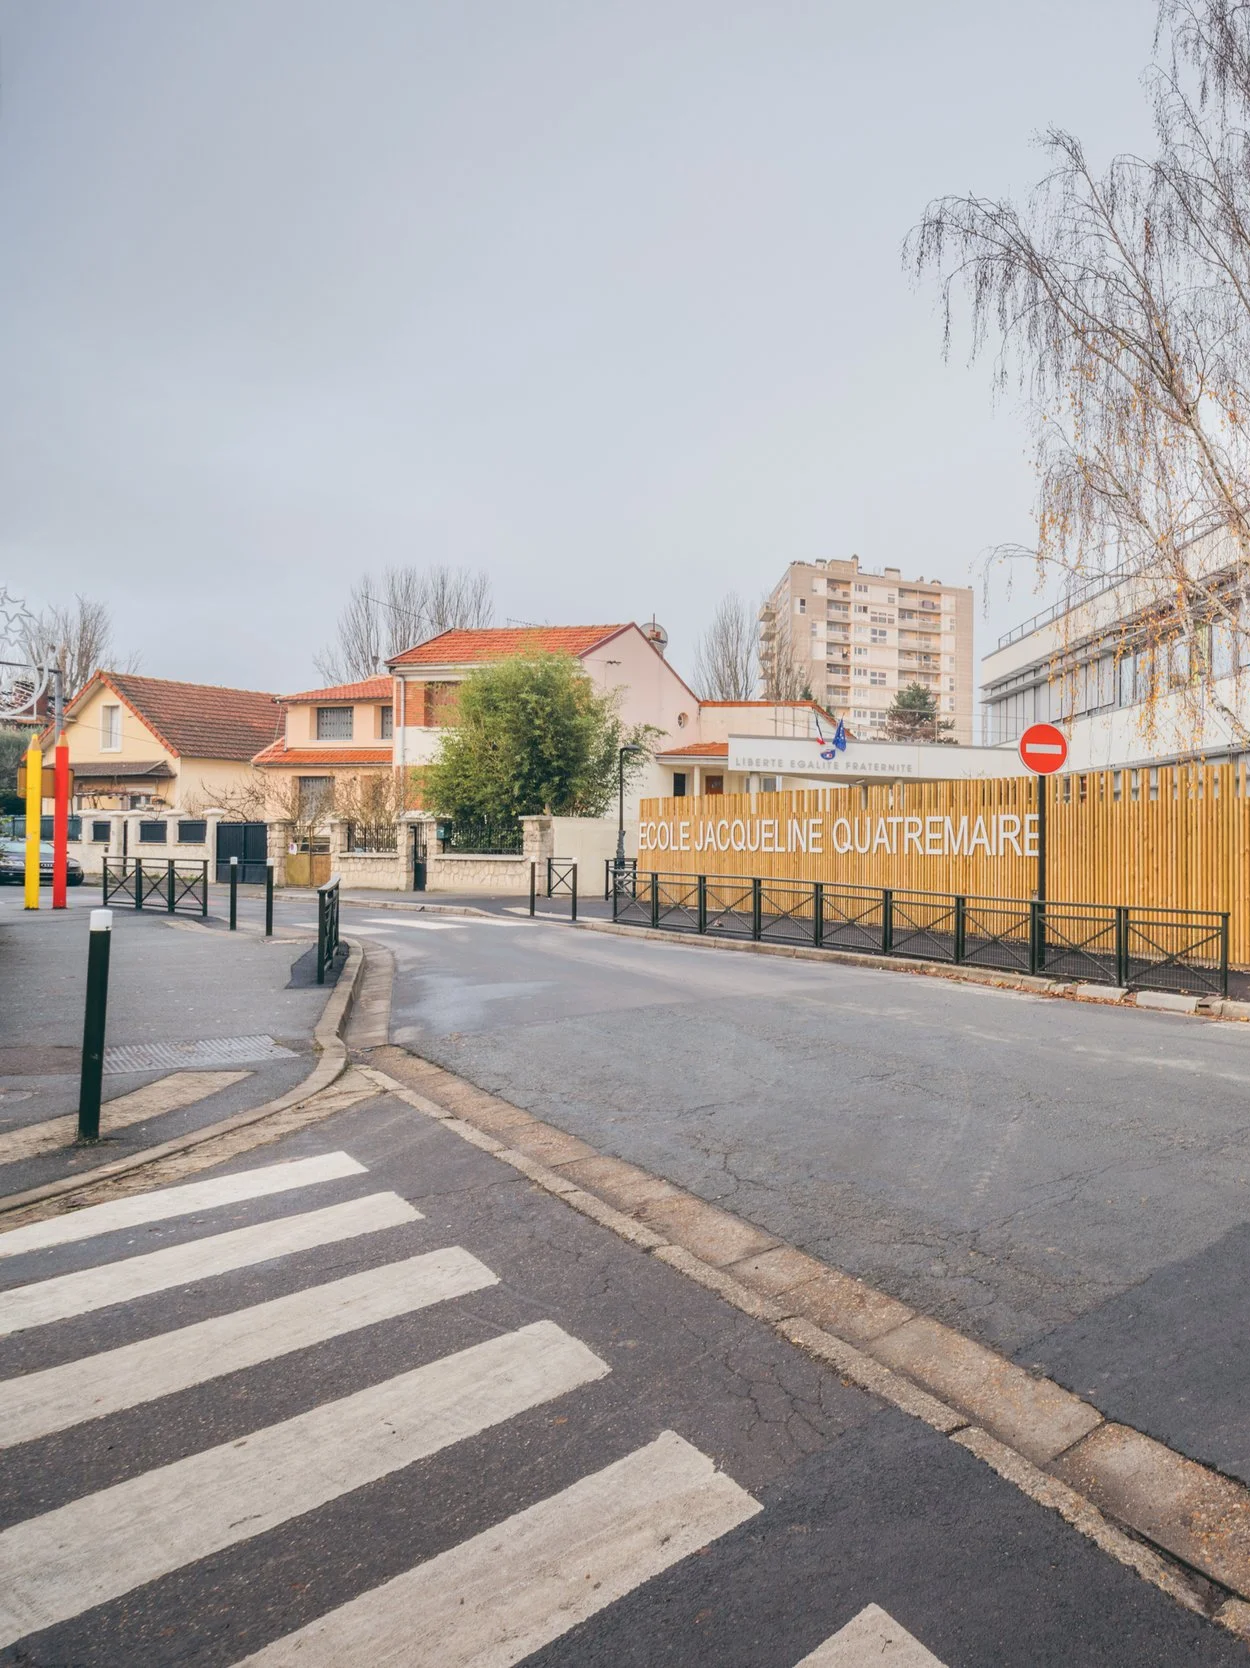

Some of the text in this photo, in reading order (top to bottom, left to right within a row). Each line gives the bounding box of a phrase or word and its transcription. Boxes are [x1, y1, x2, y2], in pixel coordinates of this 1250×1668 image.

[639, 813, 1040, 857] ECOLE JACQUELINE QUATREMAIRE
